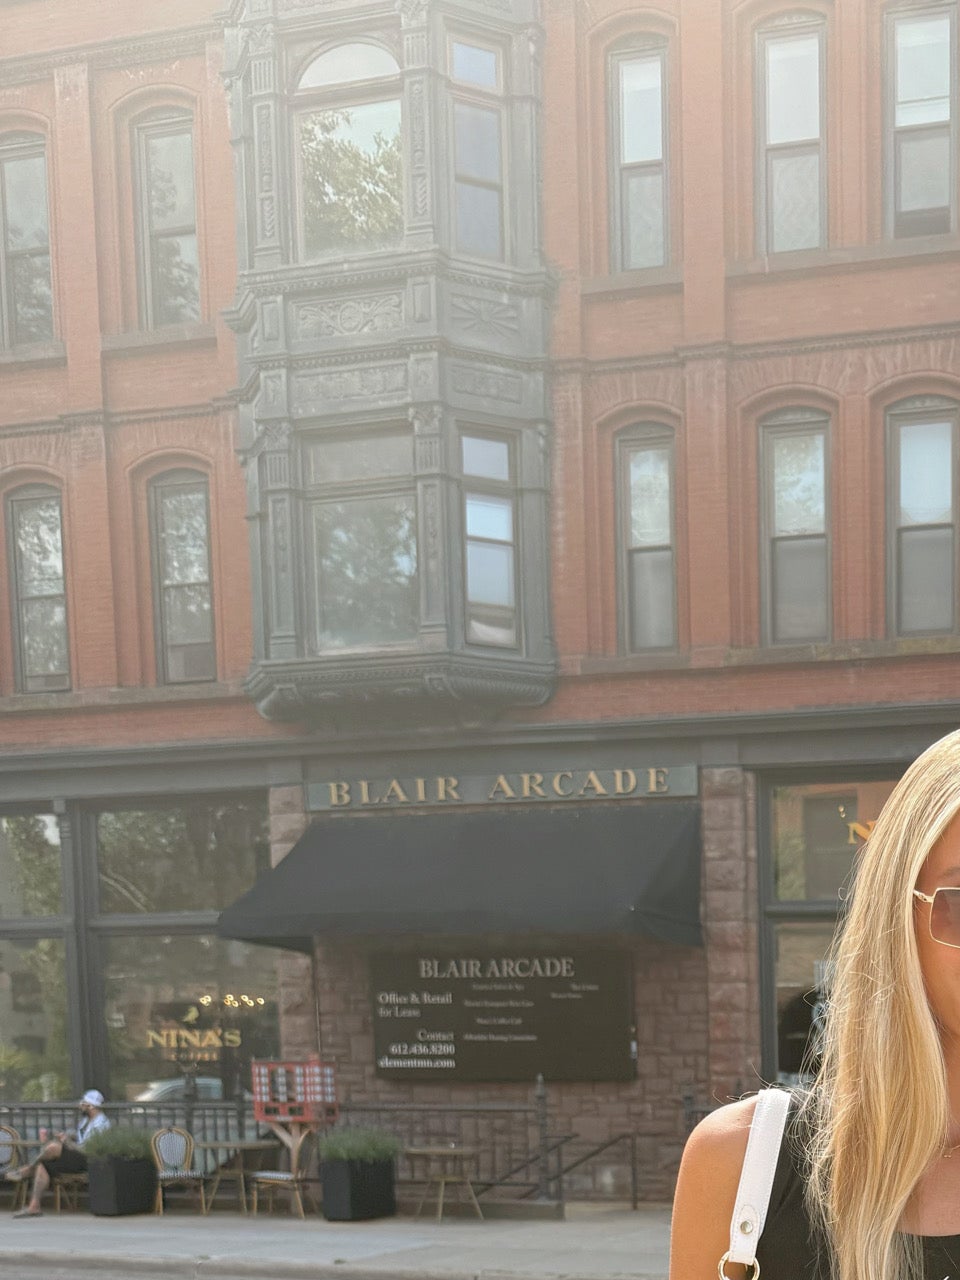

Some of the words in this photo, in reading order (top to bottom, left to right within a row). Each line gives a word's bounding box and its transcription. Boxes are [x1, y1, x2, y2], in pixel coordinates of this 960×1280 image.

[328, 775, 462, 808] BLAIR
[488, 767, 671, 801] ARCADE
[419, 959, 482, 978] BLAIR
[486, 957, 575, 978] ARCADE
[377, 991, 408, 1004] Office
[410, 992, 420, 1004] &
[422, 991, 453, 1004] Retail
[378, 1006, 392, 1017] for
[145, 1027, 242, 1048] NINA'S
[417, 1029, 454, 1041] Contact
